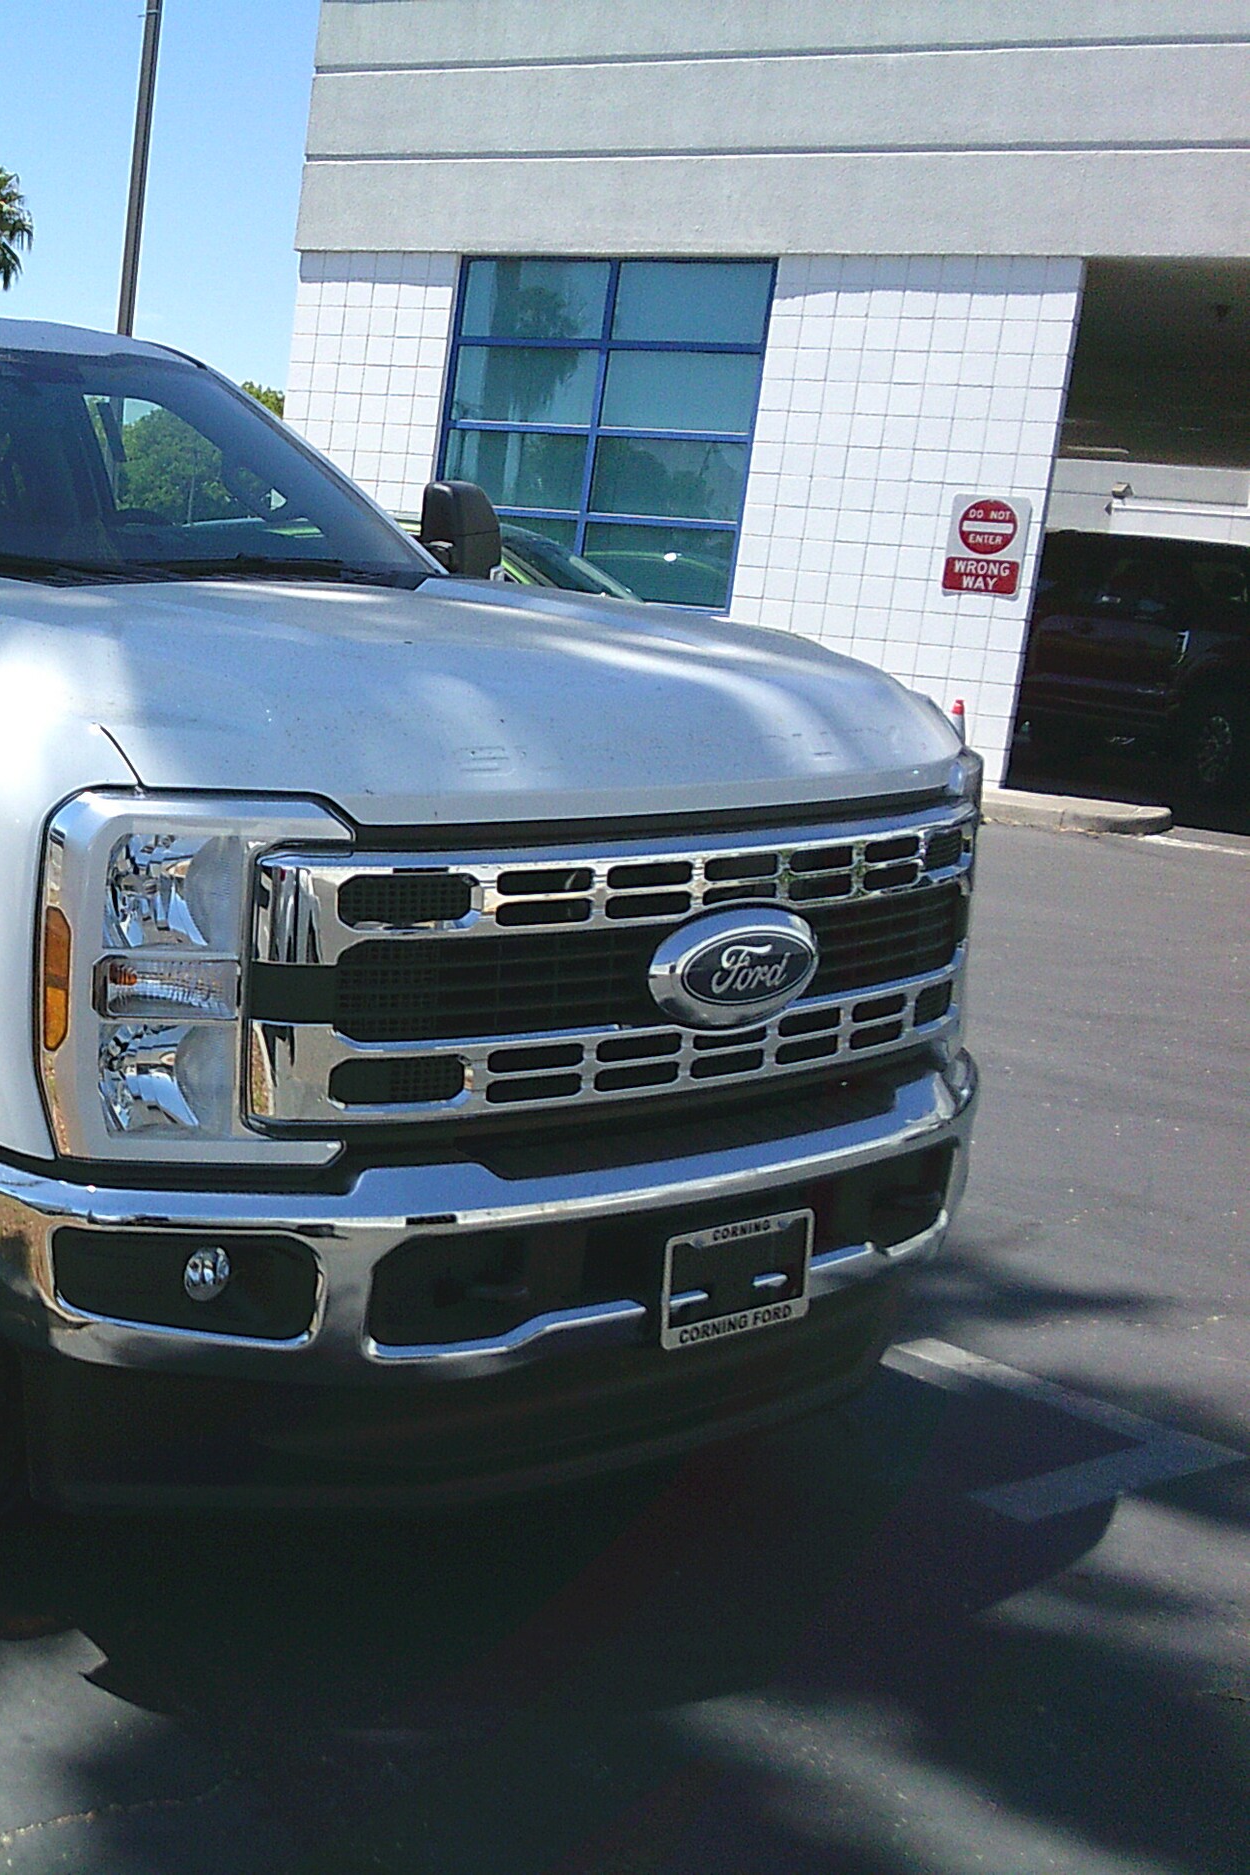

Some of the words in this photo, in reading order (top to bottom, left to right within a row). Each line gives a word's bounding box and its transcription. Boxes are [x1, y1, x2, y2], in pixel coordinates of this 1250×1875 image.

[969, 509, 984, 519] DO
[990, 510, 1011, 520] NOT
[969, 534, 1002, 544] ENTER
[954, 560, 1010, 576] WRONG
[962, 575, 997, 590] WAY
[711, 944, 791, 994] Ford
[712, 1219, 771, 1242] CORNING
[679, 1314, 748, 1344] CORNING
[753, 1305, 792, 1326] FORD
